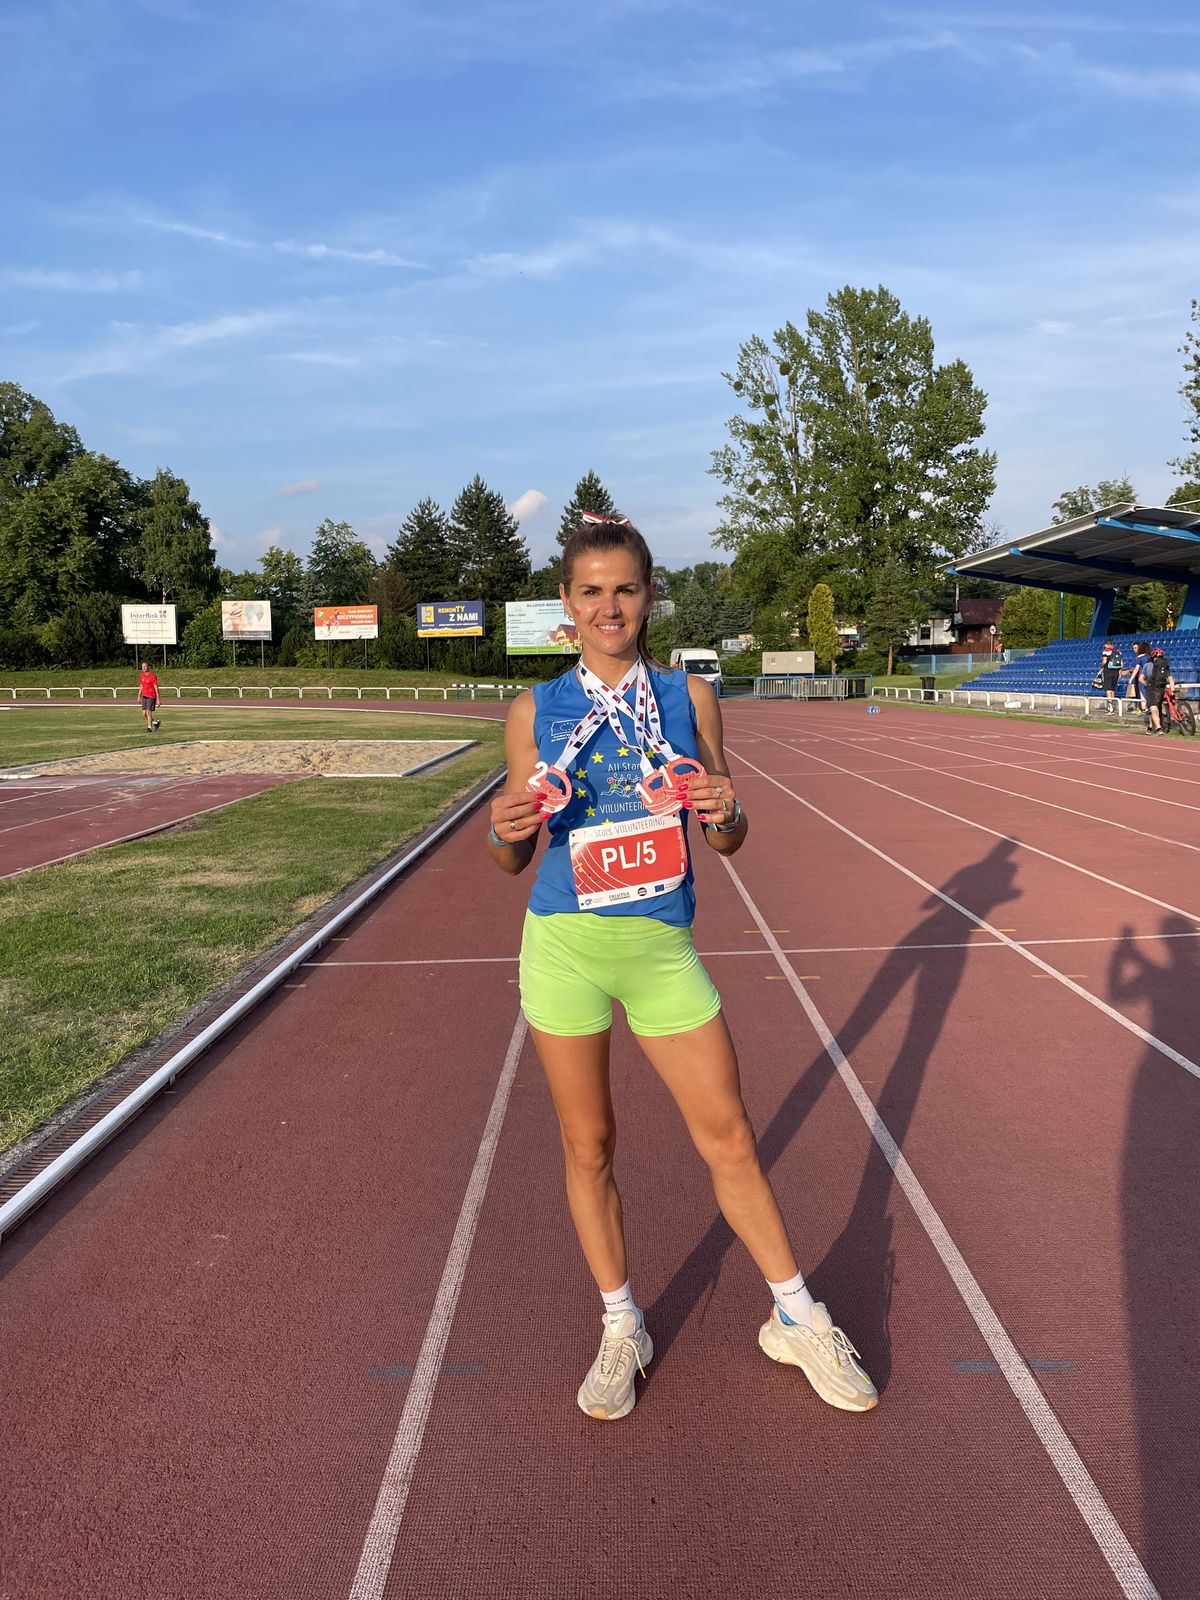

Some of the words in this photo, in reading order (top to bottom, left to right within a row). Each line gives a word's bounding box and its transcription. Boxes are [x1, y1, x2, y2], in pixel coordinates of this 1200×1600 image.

[437, 605, 466, 614] REMONTY
[449, 613, 456, 622] Z
[457, 612, 479, 622] NAMI
[608, 762, 620, 772] All
[621, 761, 640, 771] Star
[528, 761, 549, 787] 2
[614, 817, 666, 834] VOLUNTEERING
[601, 840, 657, 872] PL/5
